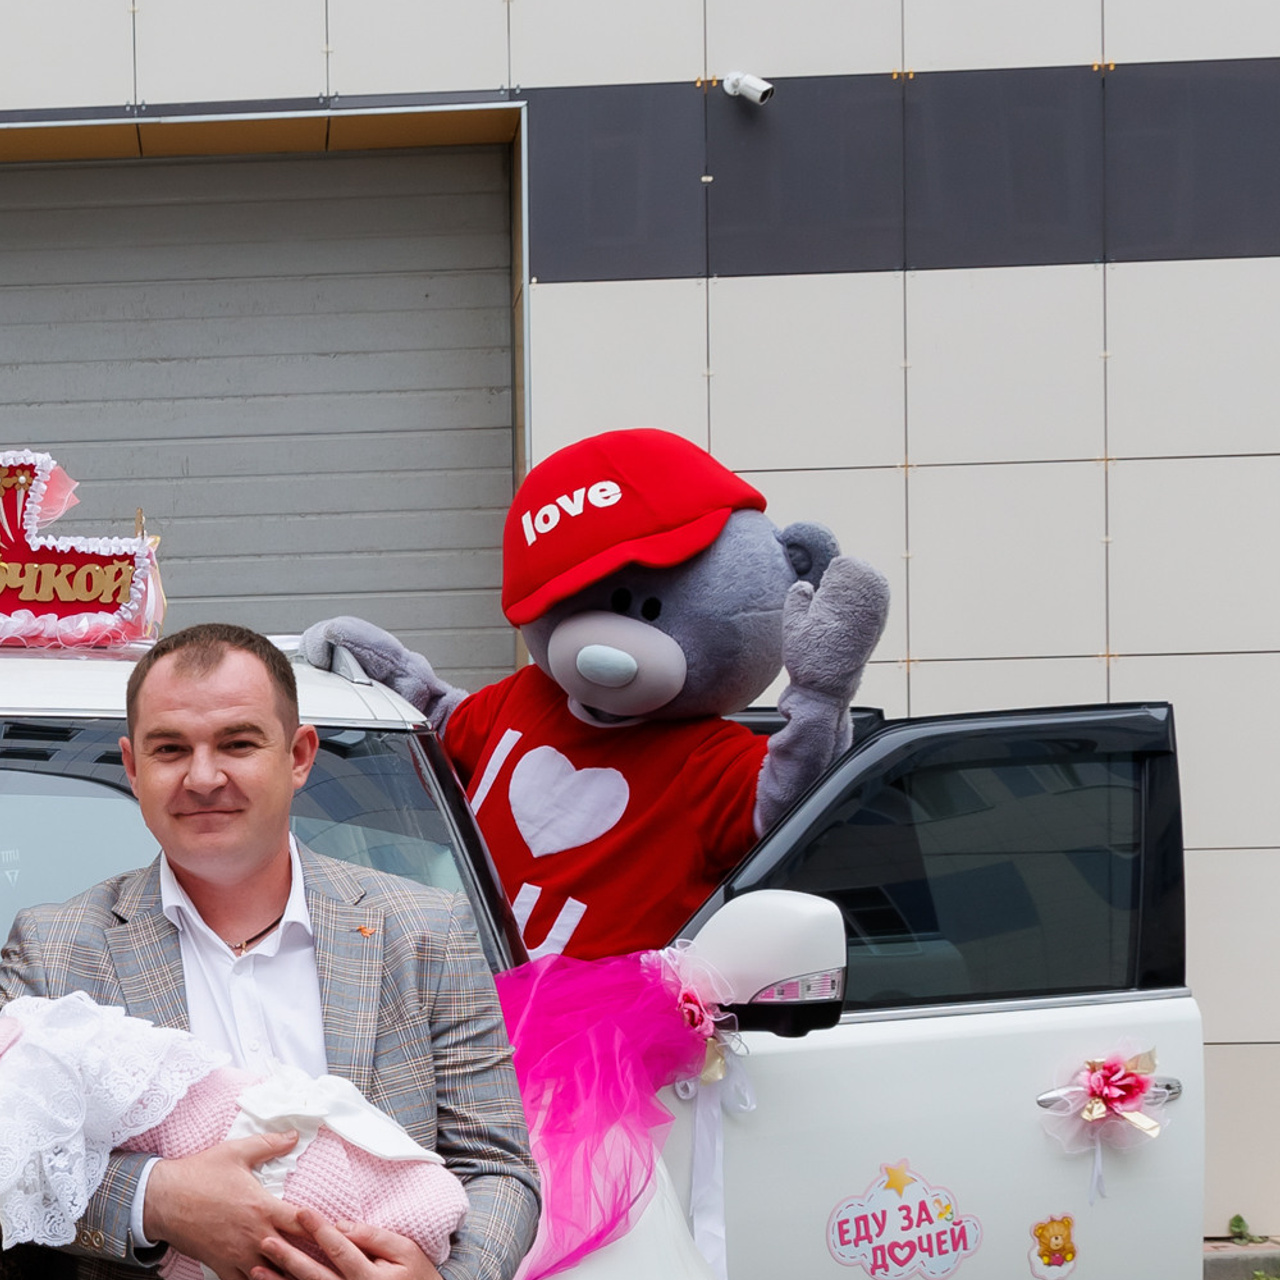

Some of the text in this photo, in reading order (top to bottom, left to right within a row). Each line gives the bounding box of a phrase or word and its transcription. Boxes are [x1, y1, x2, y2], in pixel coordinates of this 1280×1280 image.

[521, 479, 622, 546] love
[837, 1200, 934, 1247] ЕДУ ЗА
